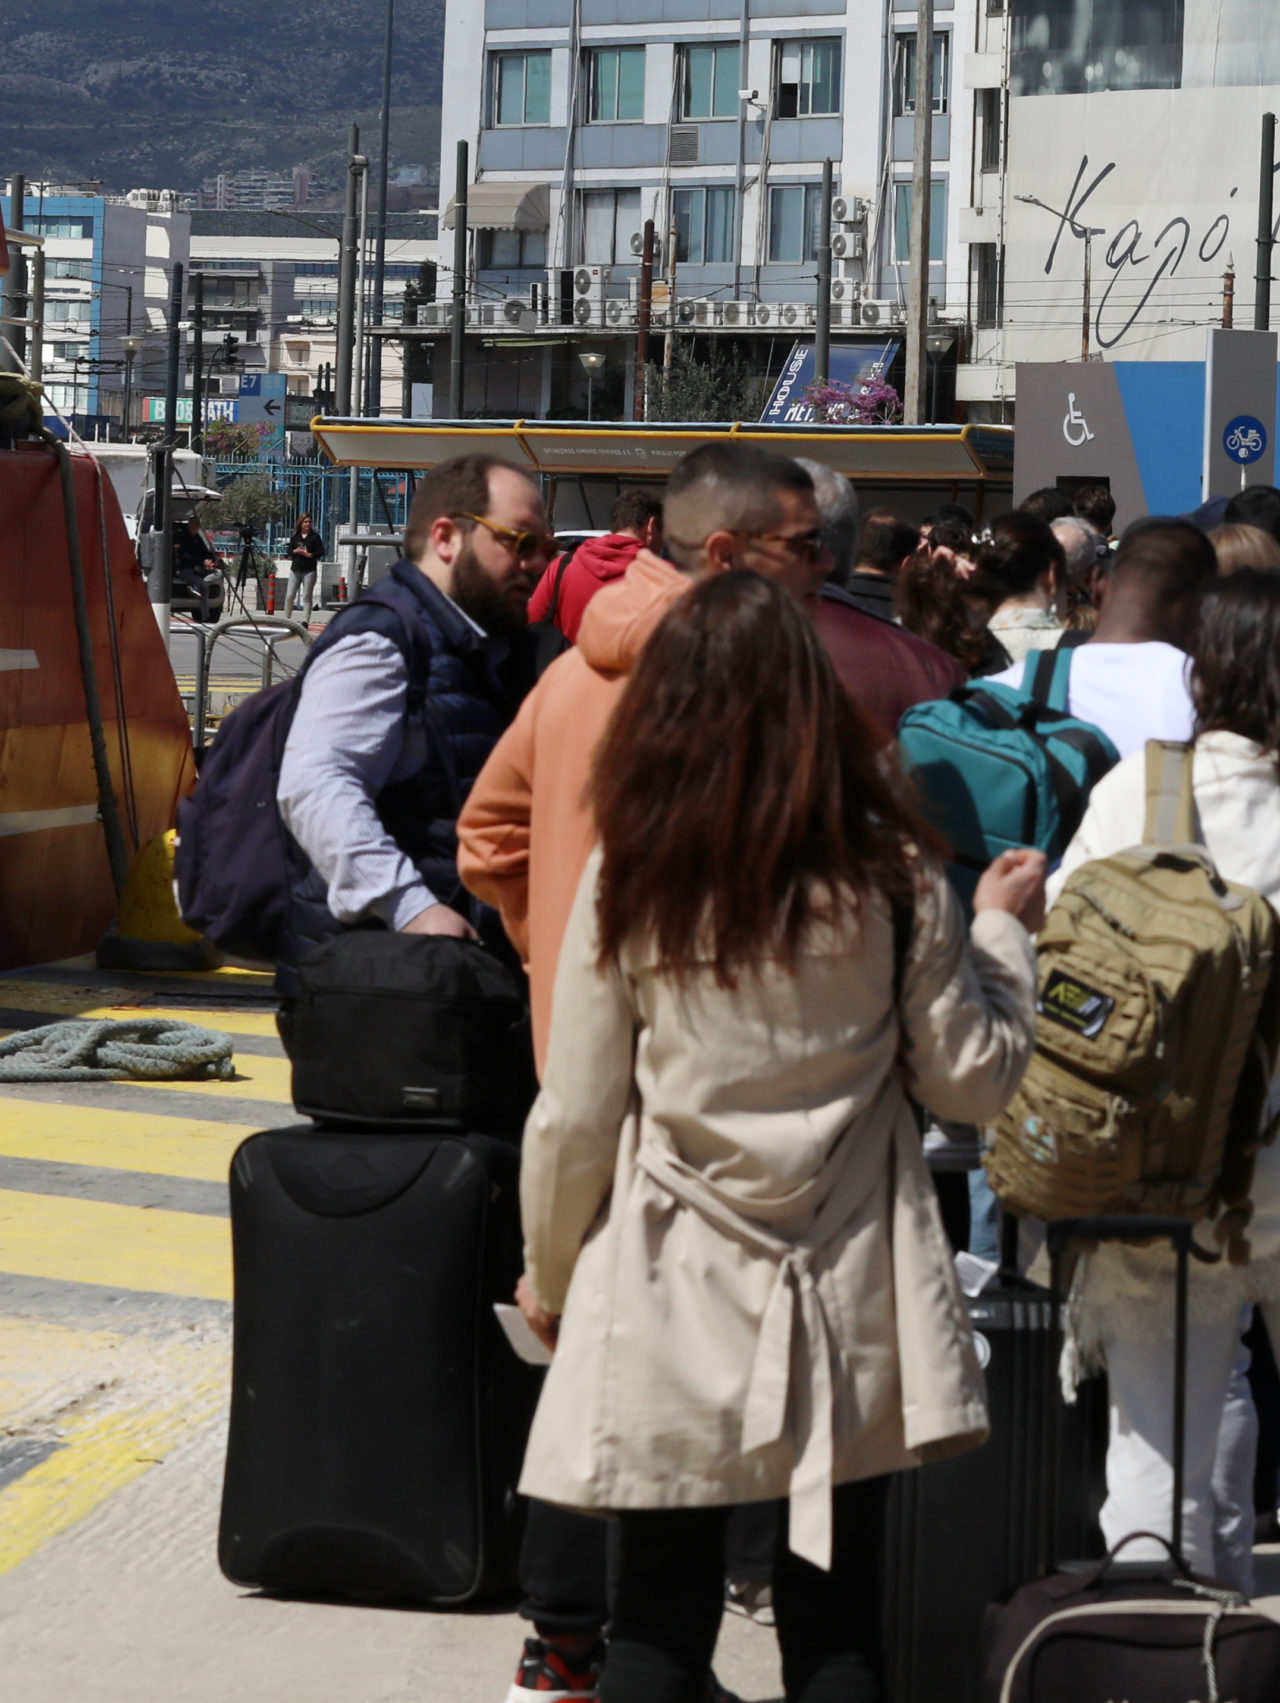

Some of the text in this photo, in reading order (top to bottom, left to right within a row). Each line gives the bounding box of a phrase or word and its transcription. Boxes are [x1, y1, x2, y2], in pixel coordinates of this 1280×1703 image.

[1044, 154, 1239, 348] Καλό
[240, 374, 257, 389] E7
[768, 348, 809, 416] HOUSE
